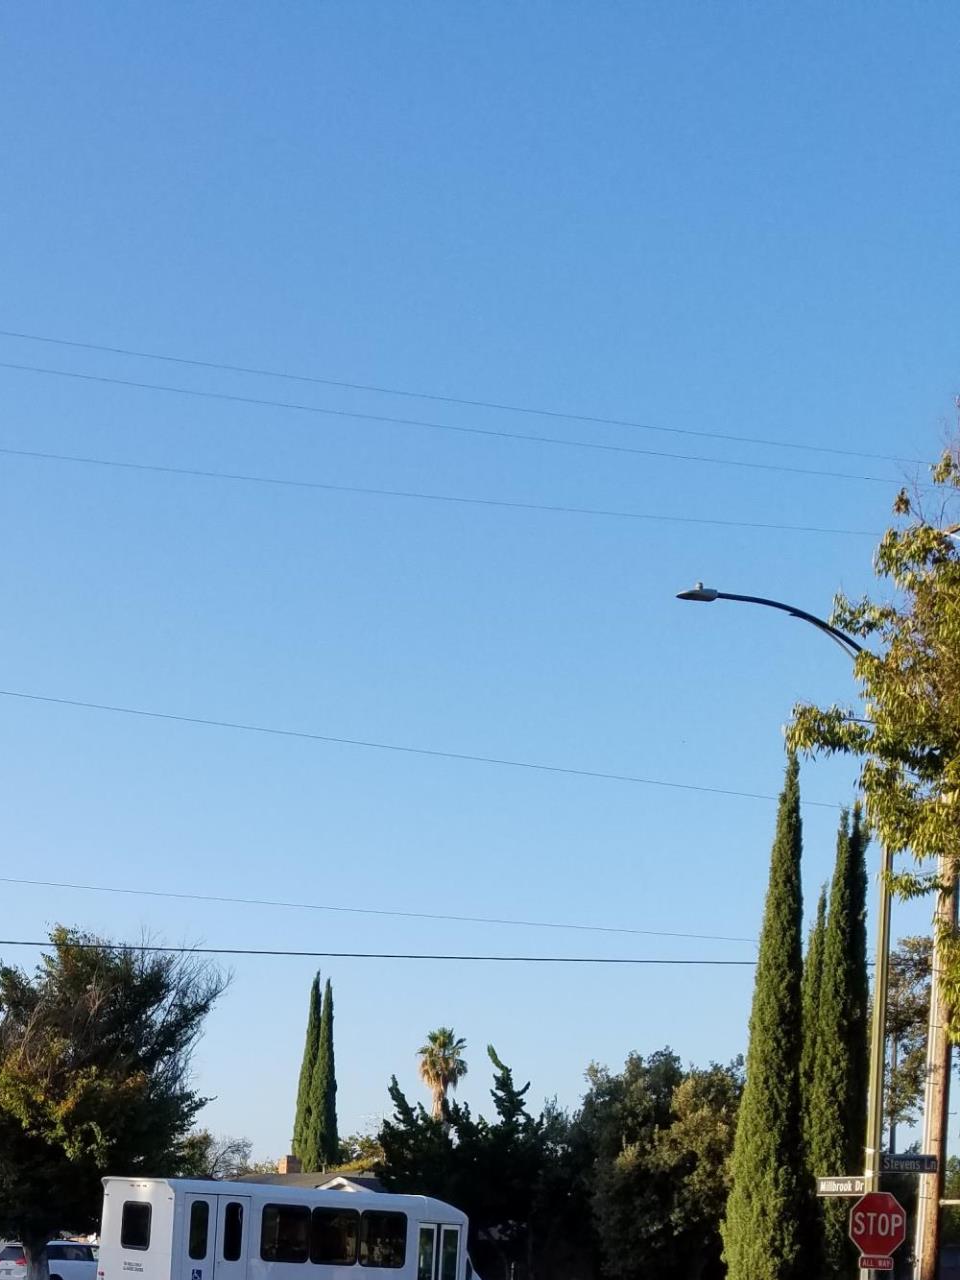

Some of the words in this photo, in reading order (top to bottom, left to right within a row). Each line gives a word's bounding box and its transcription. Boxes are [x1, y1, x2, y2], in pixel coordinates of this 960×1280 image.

[883, 1157, 921, 1169] Stevens
[924, 1158, 936, 1170] Ln
[819, 1179, 852, 1192] Millbrook
[855, 1179, 864, 1192] Dr
[853, 1211, 903, 1237] STOP
[862, 1258, 874, 1267] ALL
[877, 1259, 891, 1268] WAY
